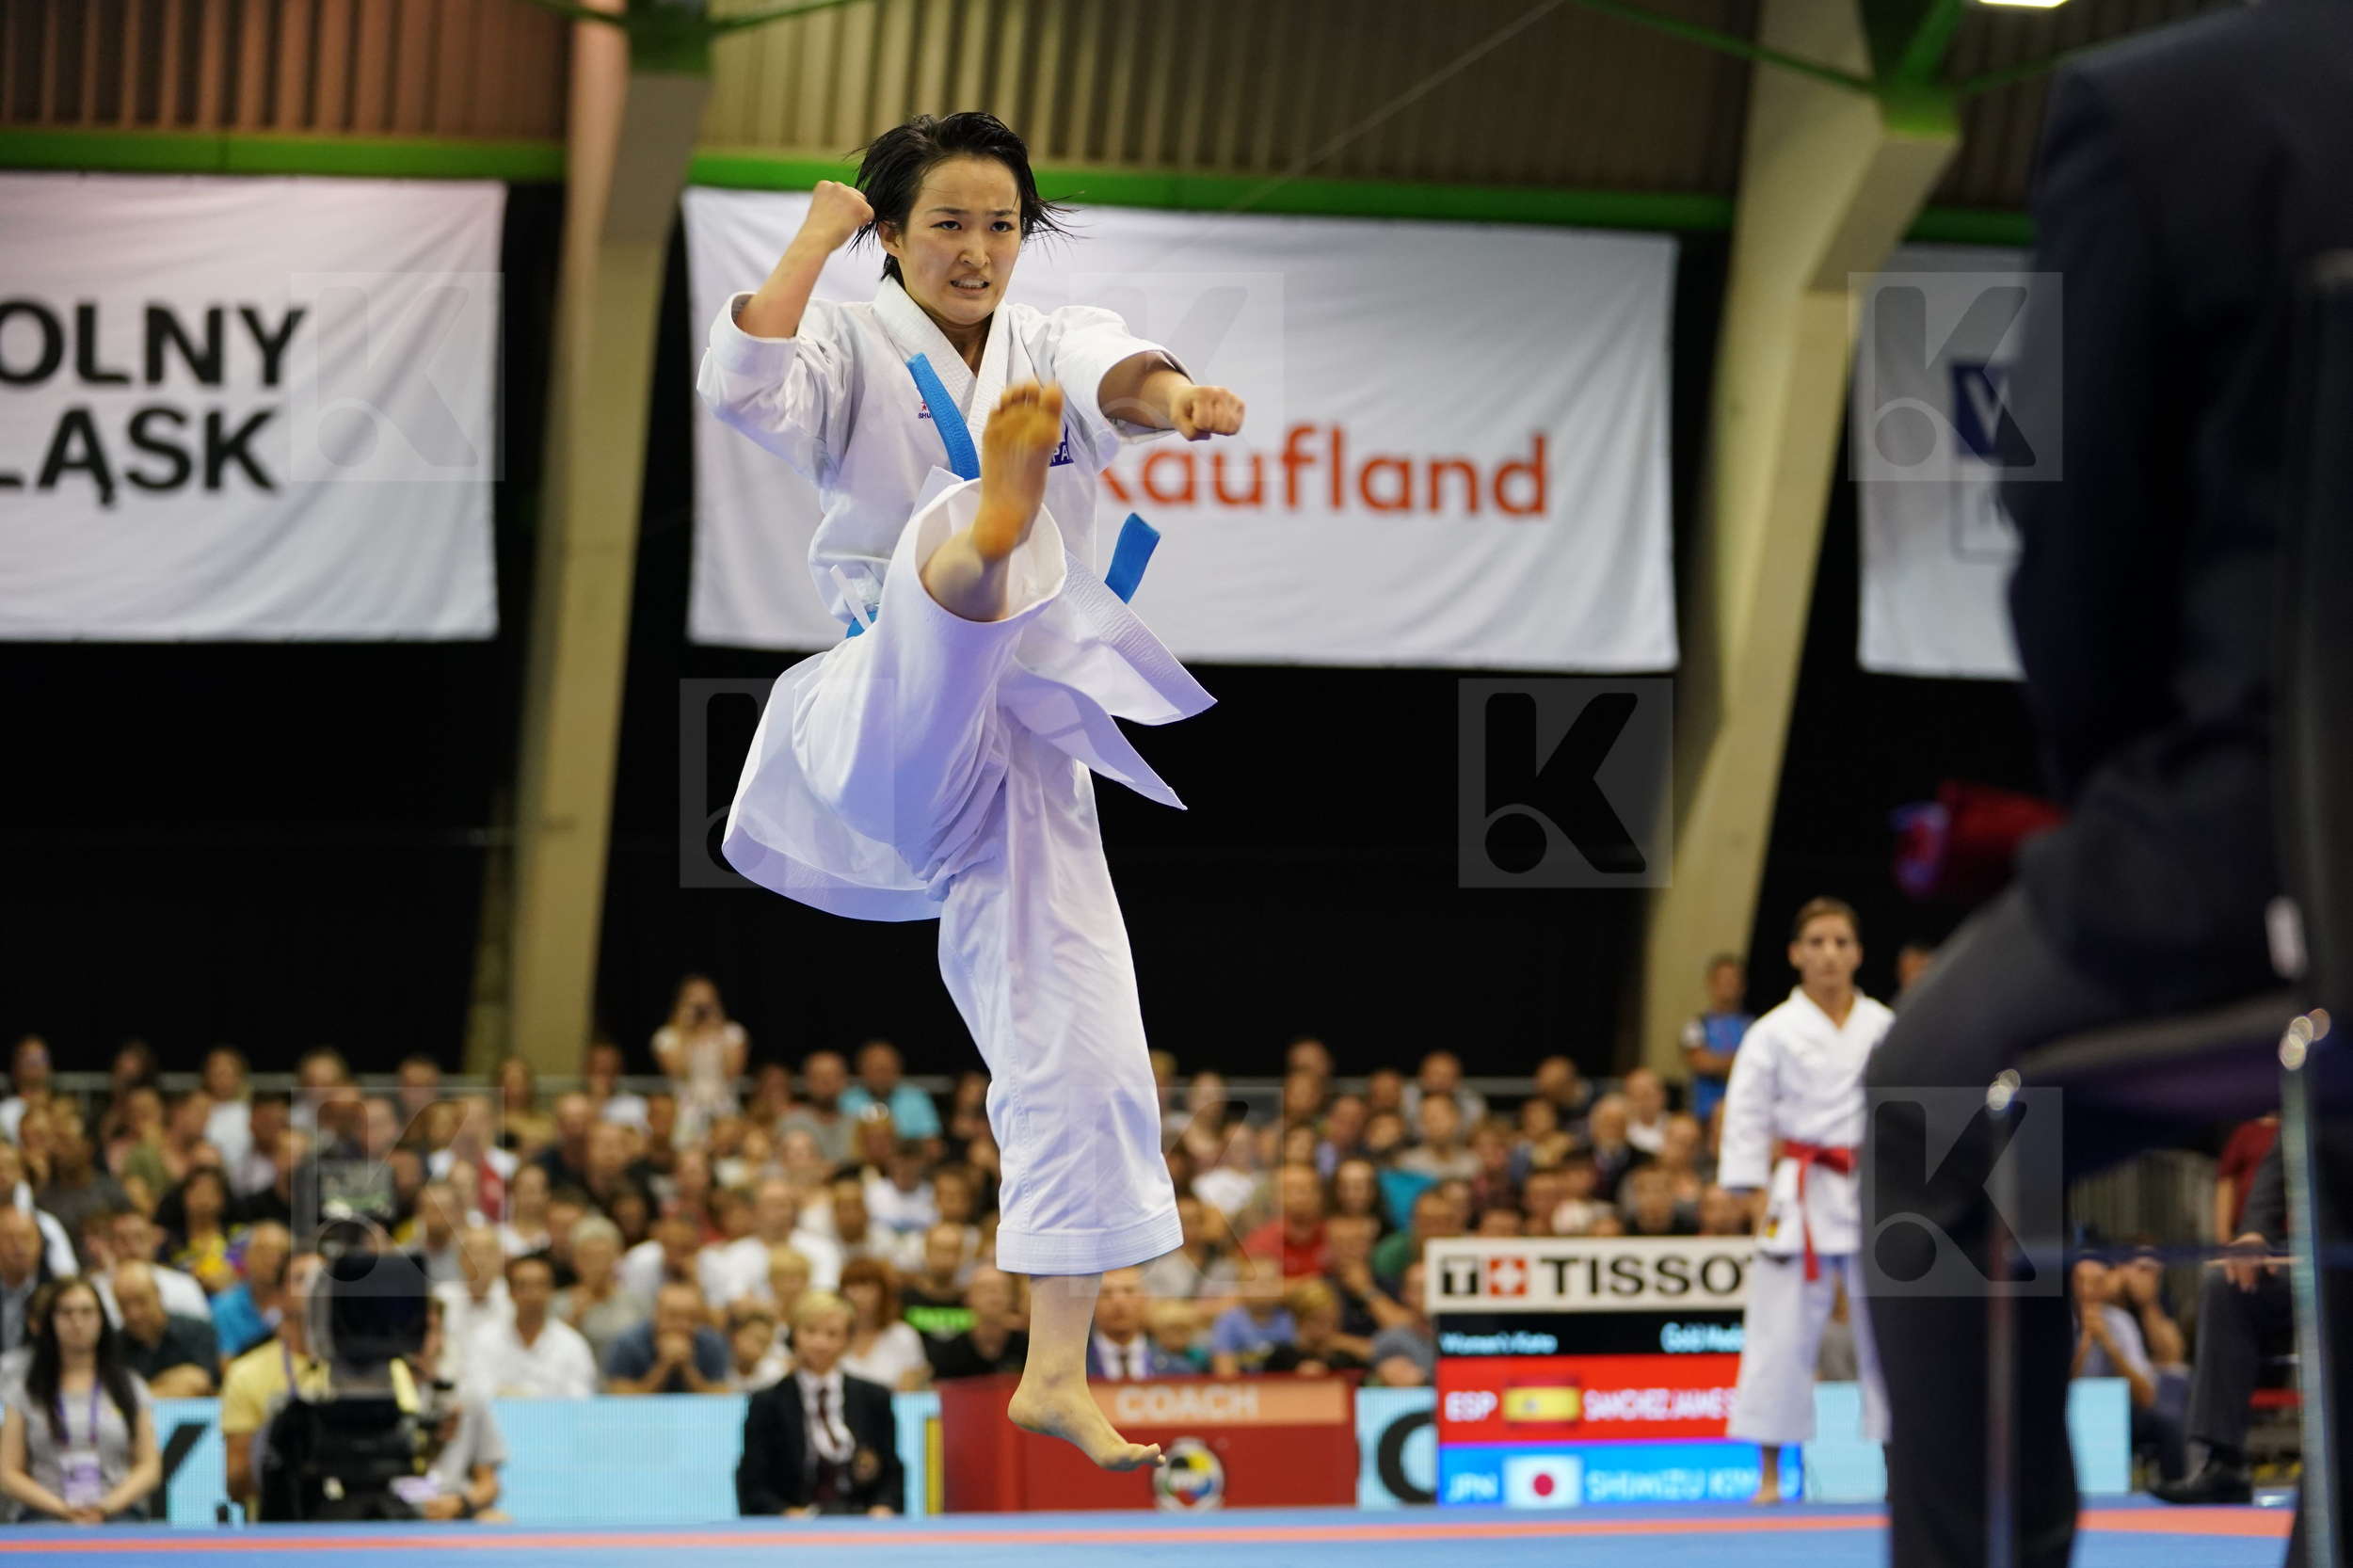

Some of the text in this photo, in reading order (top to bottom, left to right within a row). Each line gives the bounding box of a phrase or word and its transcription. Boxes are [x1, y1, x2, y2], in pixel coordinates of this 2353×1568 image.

[0, 300, 308, 388] OLNY
[1539, 1255, 1753, 1296] TISSO
[1116, 1385, 1259, 1422] COACH
[1445, 1390, 1497, 1422] ESP
